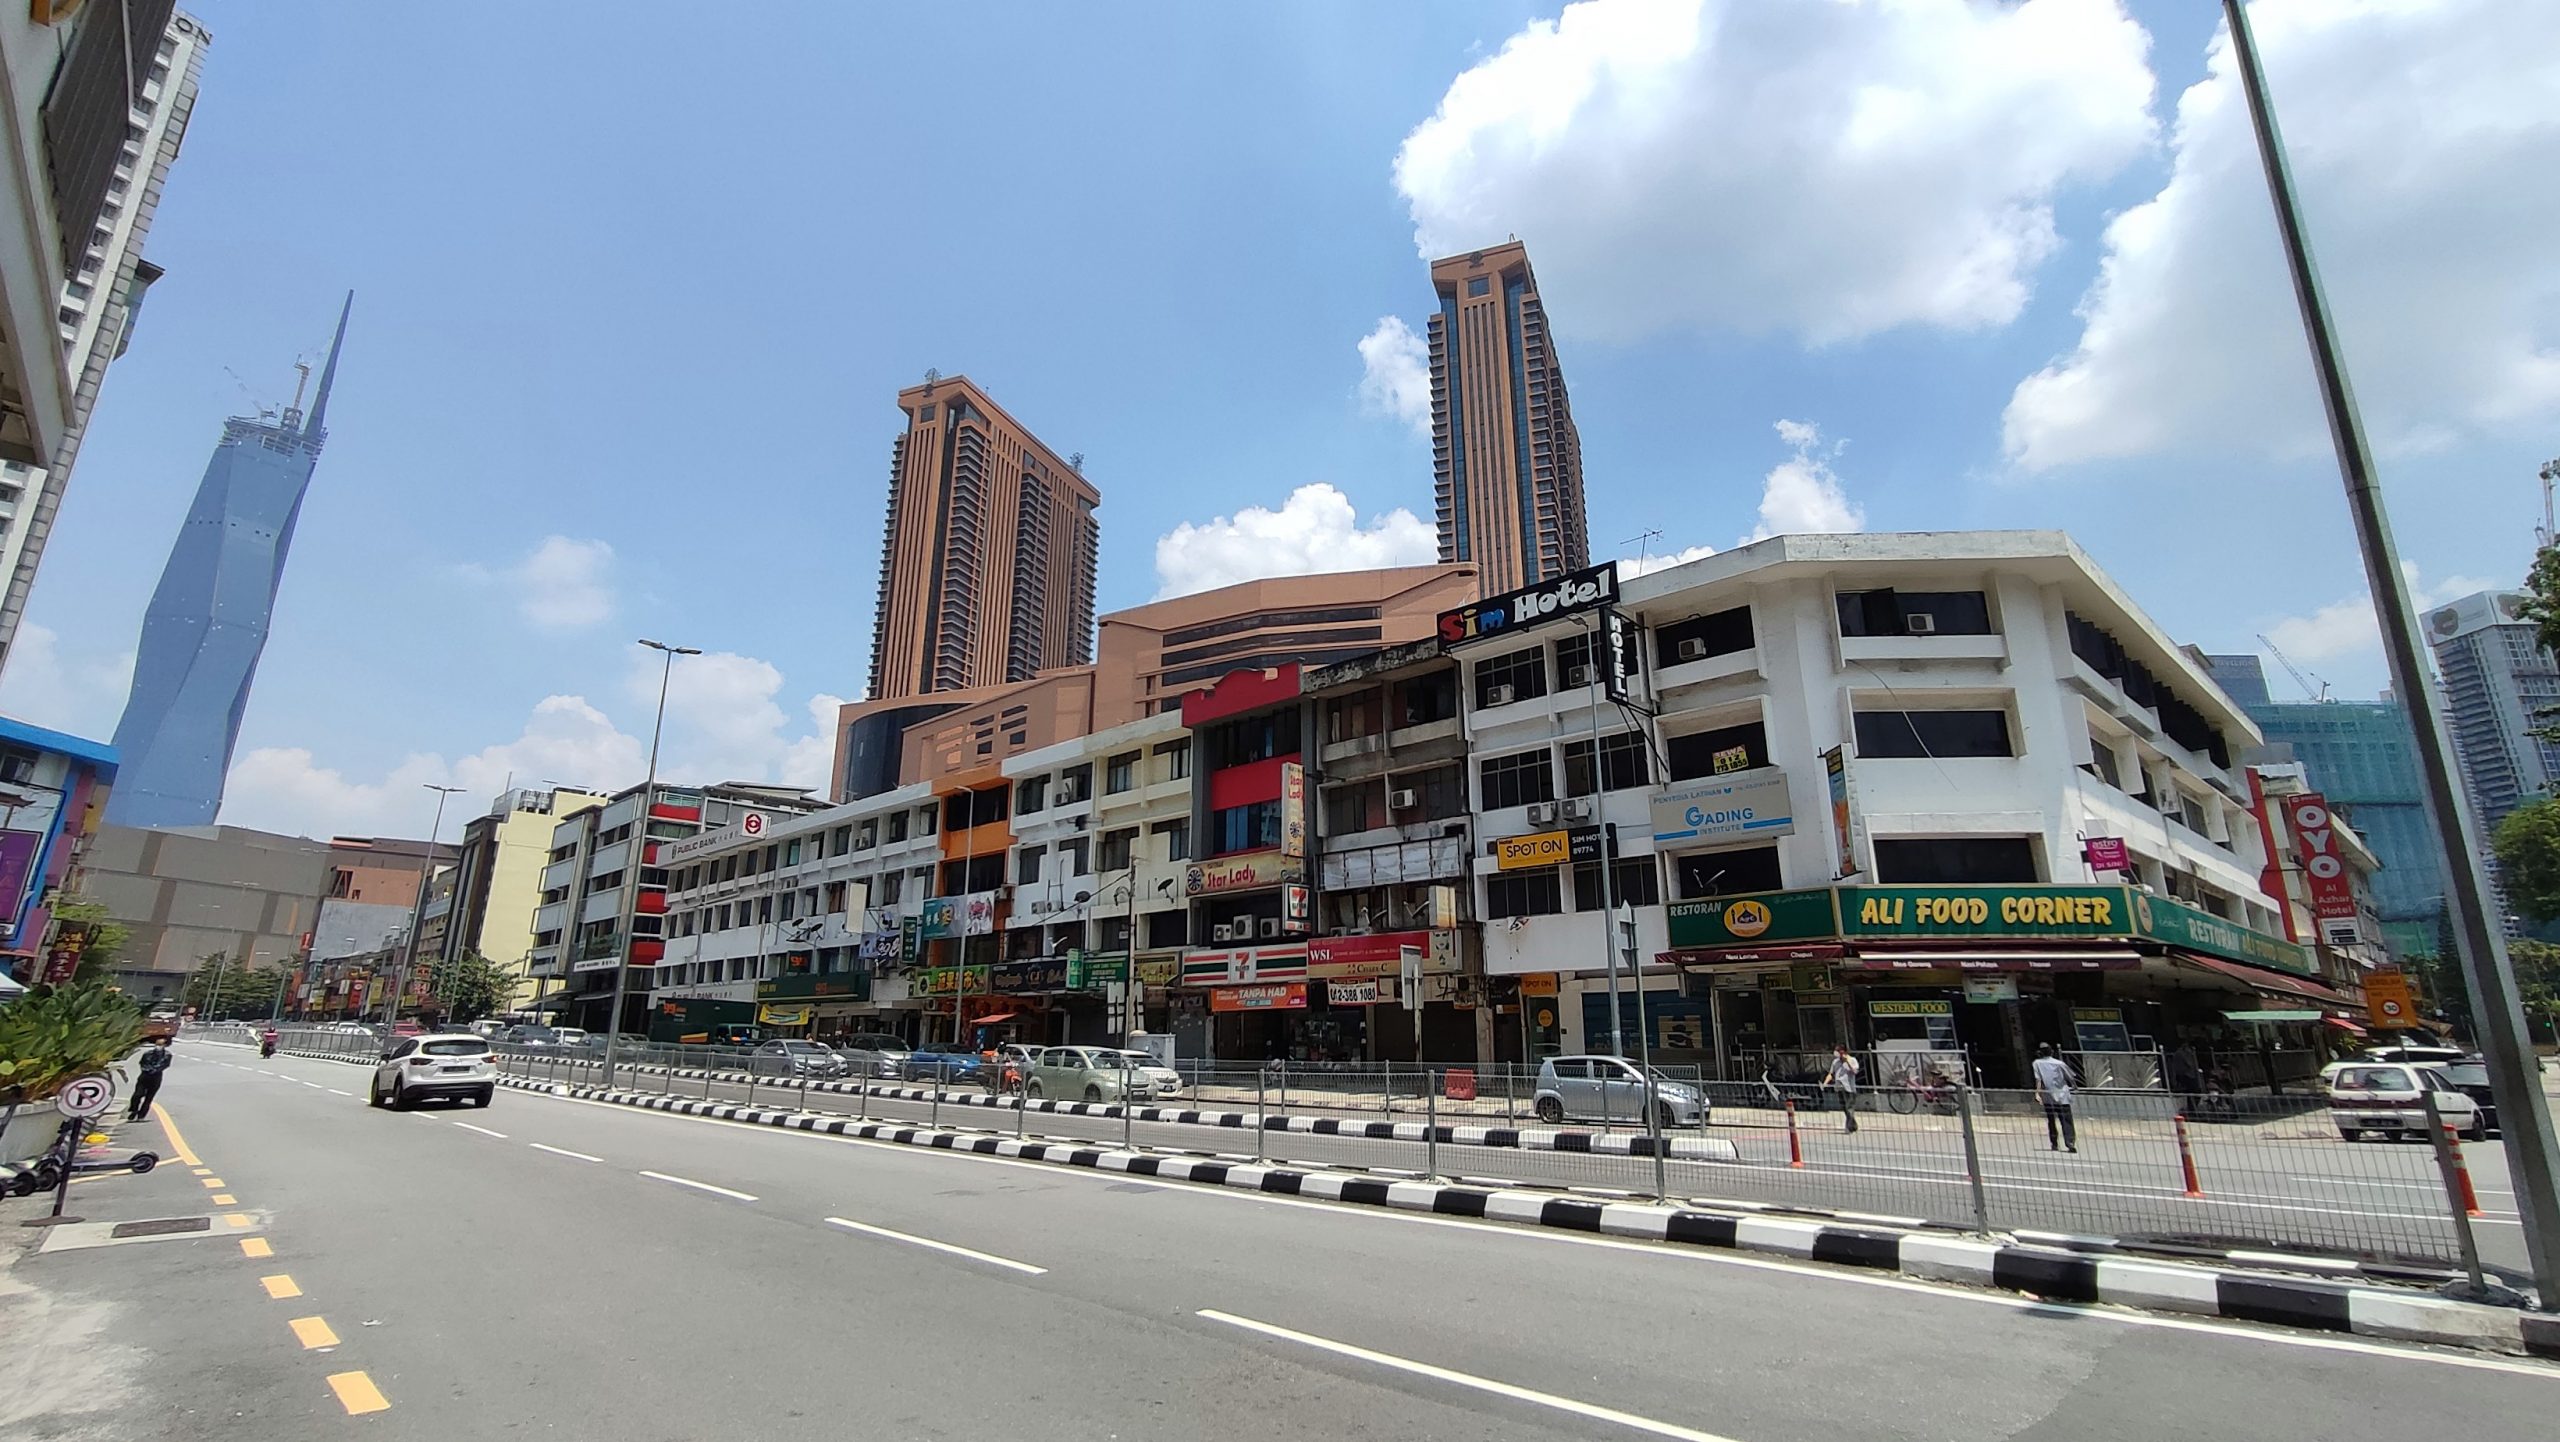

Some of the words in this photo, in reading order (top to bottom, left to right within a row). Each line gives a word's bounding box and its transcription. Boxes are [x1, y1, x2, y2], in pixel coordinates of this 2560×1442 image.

[1440, 608, 1505, 641] Sim
[1512, 569, 1612, 623] Hotel
[1609, 615, 1626, 694] HOTEL
[1685, 806, 1753, 827] GADING
[1572, 836, 1585, 844] SIM
[1586, 832, 1611, 842] HOTL
[1699, 824, 1741, 834] INSTITUTE
[677, 841, 698, 854] PUBLIC
[700, 836, 717, 848] BANK
[1506, 842, 1538, 858] SPOT
[1541, 839, 1562, 853] ON
[2092, 840, 2118, 849] astro
[2296, 805, 2341, 879] OYO
[1207, 871, 1227, 888] Star
[1229, 863, 1256, 883] Lady
[1670, 901, 1722, 917] RESTORAN
[1861, 897, 1904, 925] ALI
[1916, 897, 1989, 925] FOOD
[2001, 896, 2112, 926] CORNER
[2321, 906, 2353, 915] Hotel
[2187, 917, 2240, 951] RESTORAN
[1310, 949, 1334, 961] WSL
[1872, 1002, 1918, 1014] WESTERN
[1921, 1002, 1948, 1013] FOOD
